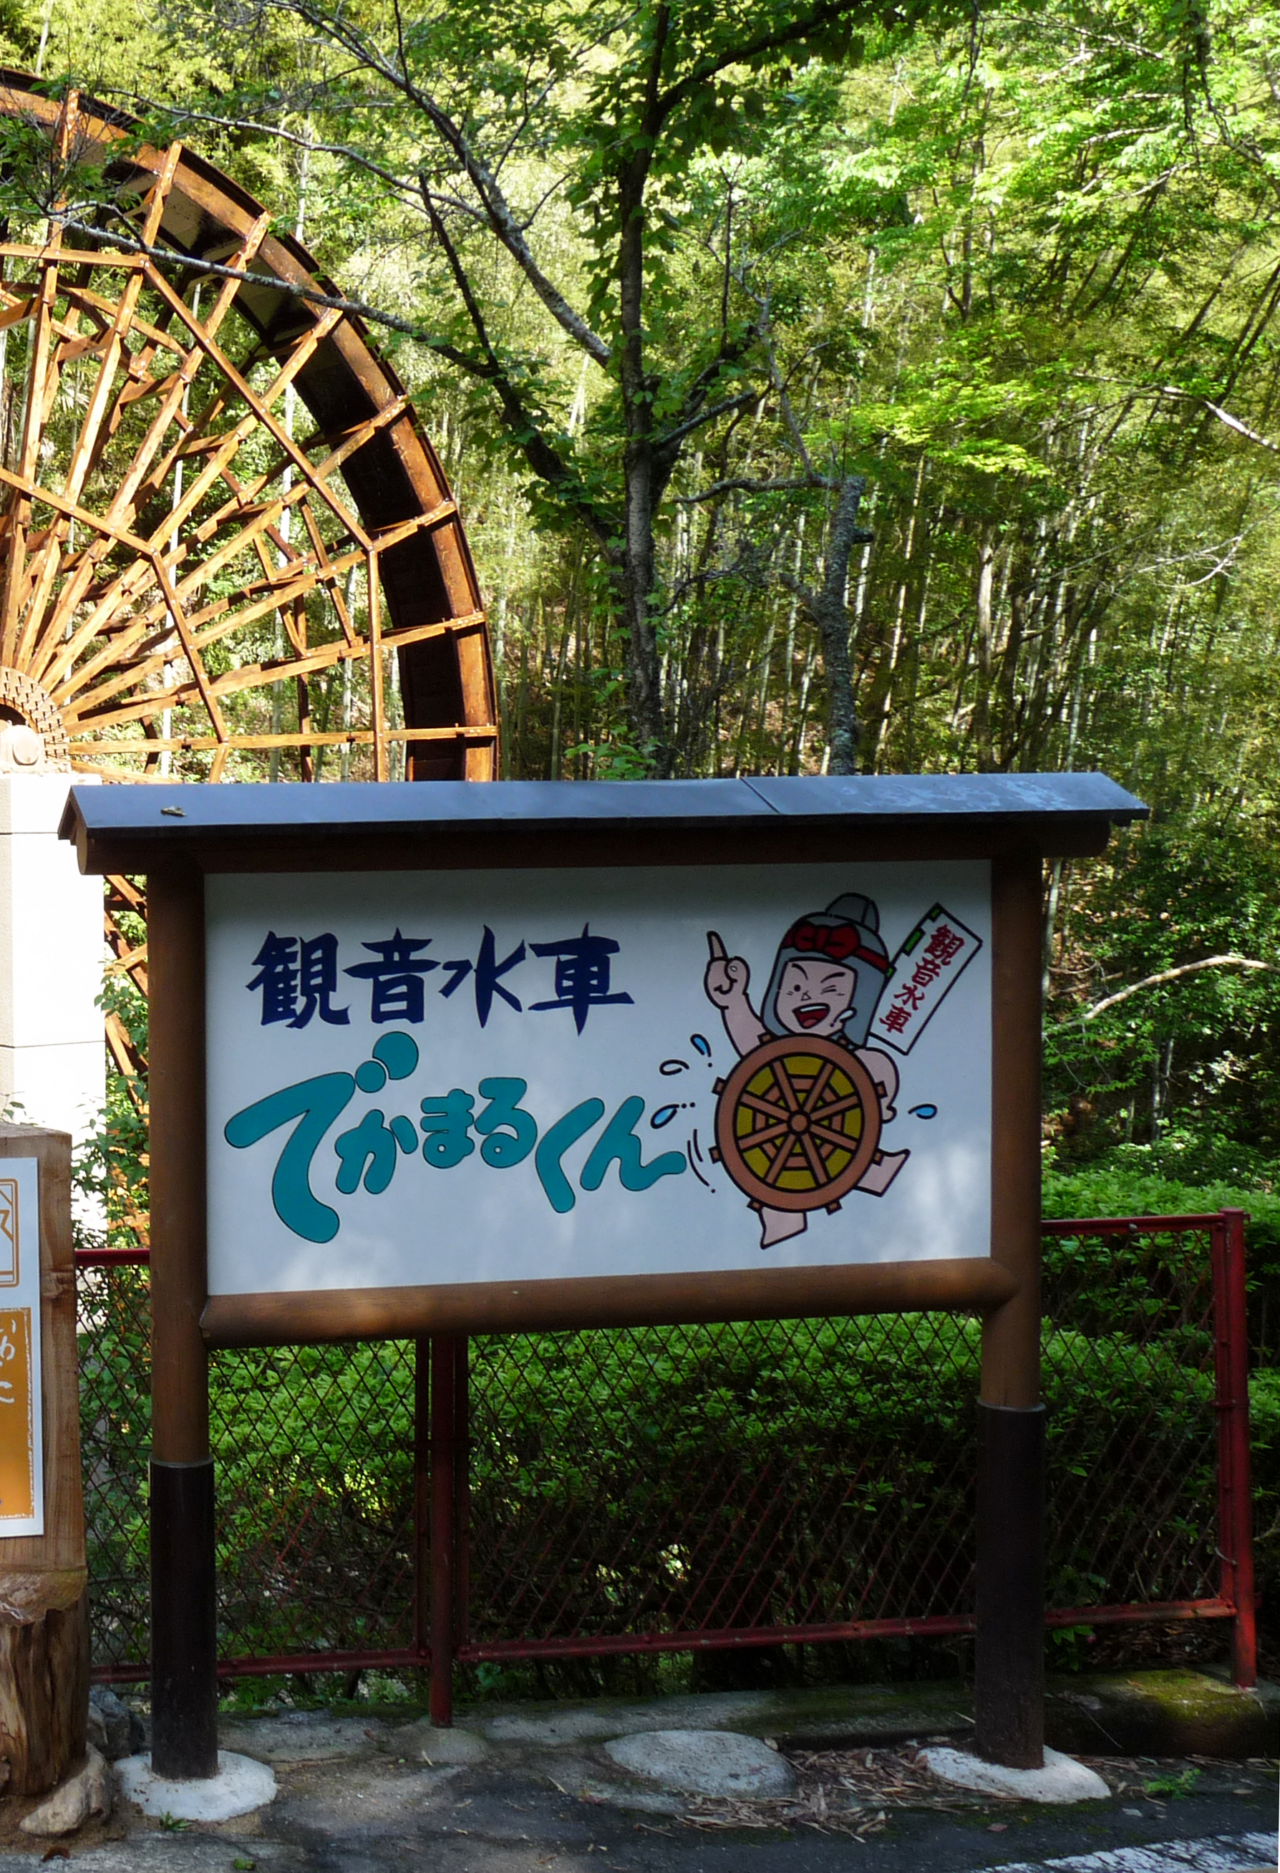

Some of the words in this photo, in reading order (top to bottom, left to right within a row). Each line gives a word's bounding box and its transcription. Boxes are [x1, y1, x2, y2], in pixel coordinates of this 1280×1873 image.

[245, 922, 635, 1036] 観音水車
[879, 923, 965, 1034] 観音水車
[224, 1031, 687, 1244] でかまるくん
